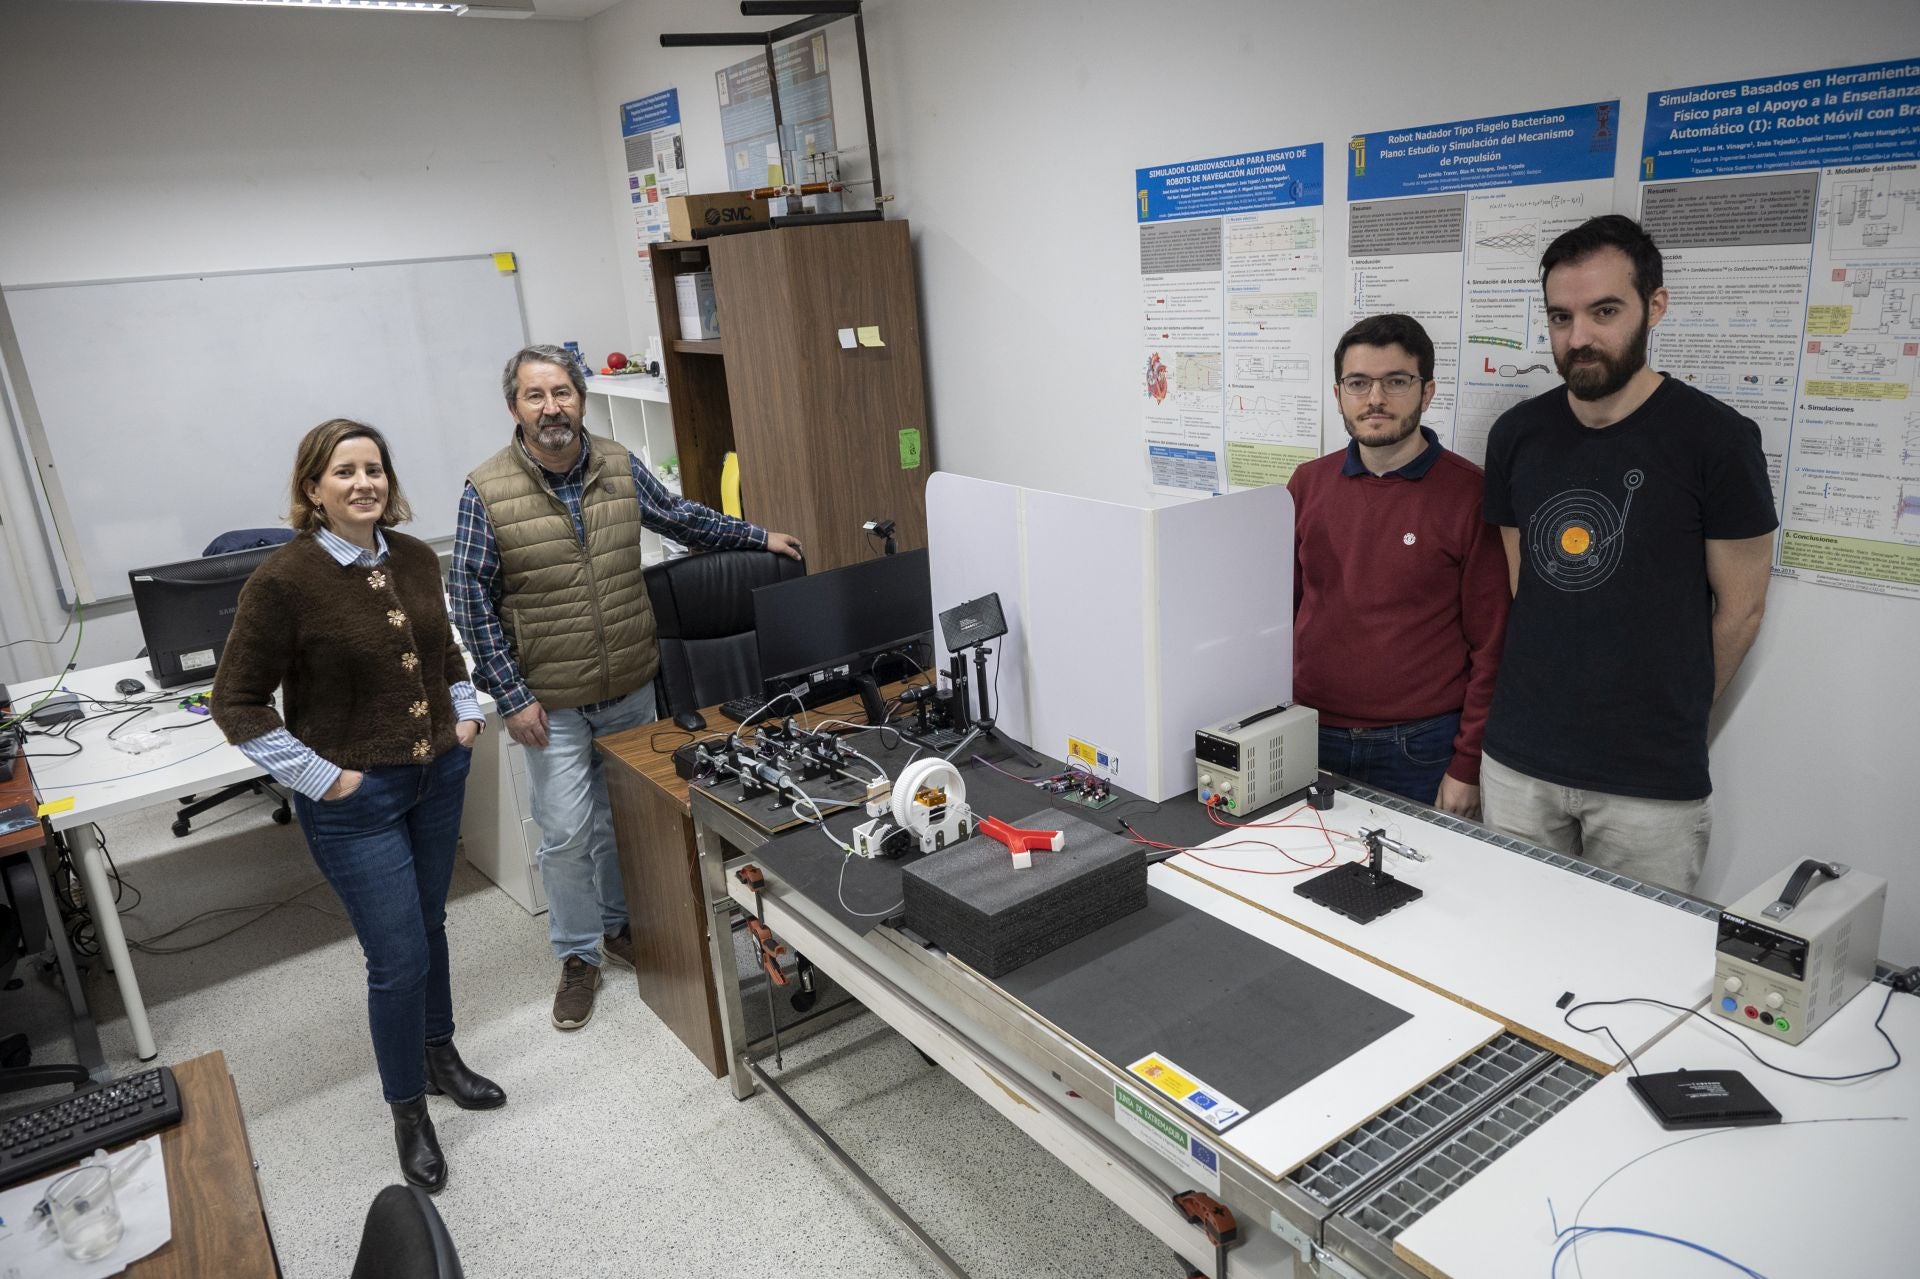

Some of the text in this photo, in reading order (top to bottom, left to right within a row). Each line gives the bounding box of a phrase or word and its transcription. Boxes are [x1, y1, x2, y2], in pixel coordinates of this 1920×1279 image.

[1659, 65, 1920, 107] Simuladores Basados en Herramienta
[1673, 109, 1709, 122] Físico
[1713, 106, 1742, 120] para
[1747, 102, 1760, 114] el
[1763, 99, 1808, 113] Apoyo
[1811, 97, 1820, 107] a
[1824, 93, 1838, 105] la
[1388, 114, 1565, 144] Robot Nadador Tipo Flagelo Bacteriano
[1669, 123, 1744, 140] Automático
[1748, 119, 1772, 134] (I):
[1777, 114, 1820, 129] Robot
[1823, 108, 1863, 124] Móvil
[1867, 107, 1894, 119] con
[1380, 129, 1574, 159] Plano: Estudio y Simulación del Mecanismo
[1440, 150, 1501, 167] de Propulsión
[1149, 149, 1307, 179] SIMULADOR CARDIOVASCULAR PARA ENSAYO DE
[1166, 163, 1286, 186] ROBOTS DE NAVEGACIÓN AUTÓNOMA
[1834, 166, 1871, 175] Modelado
[1886, 163, 1917, 171] sistema
[721, 206, 752, 222] SMC
[1807, 404, 1855, 413] Simulaciones
[1722, 913, 1746, 926] TENMA
[1119, 1091, 1185, 1144] JUNTA DE EXTREMADURA
